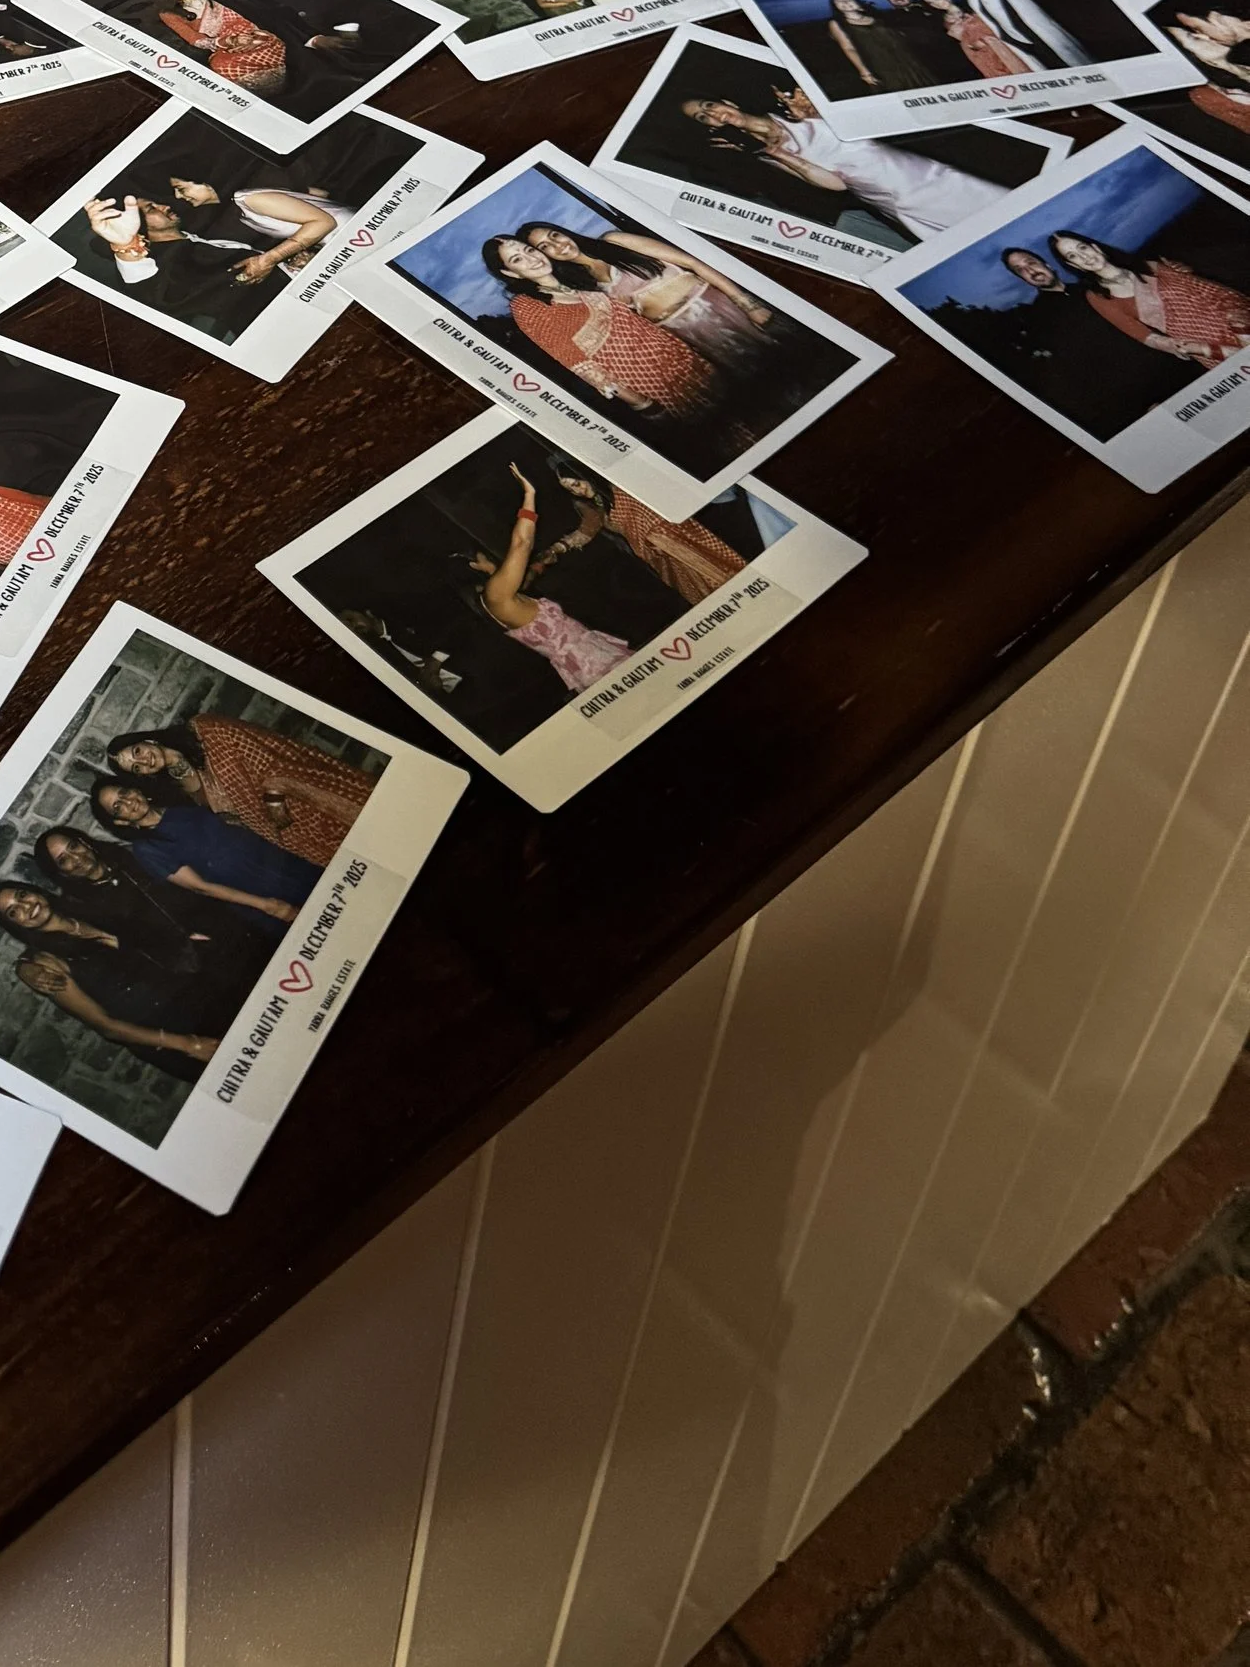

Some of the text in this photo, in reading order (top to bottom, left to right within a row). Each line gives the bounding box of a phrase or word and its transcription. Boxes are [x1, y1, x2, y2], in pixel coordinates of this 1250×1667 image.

[40, 60, 62, 71] 2025
[92, 21, 120, 37] CHITRA
[124, 38, 158, 57] GAUTAM
[177, 66, 219, 91] DECEMBER
[227, 94, 250, 108] 2025
[298, 278, 327, 303] CHITRA
[324, 246, 356, 275] GAUTAM
[364, 199, 400, 231] DECEMBER
[400, 177, 421, 194] 2025
[432, 318, 467, 342] CHITRA
[472, 346, 514, 375] GAUTAM
[538, 390, 591, 428] DECEMBER
[602, 434, 631, 453] 2025
[0, 563, 35, 602] GAUTAM
[43, 495, 83, 538] DECEMBER
[82, 463, 104, 485] 2025
[579, 689, 619, 719] CHITRA
[621, 656, 665, 689] GAUTAM
[684, 604, 737, 642] DECEMBER
[742, 577, 770, 599] 2025
[216, 1058, 253, 1104] CHITRA
[249, 994, 289, 1048] GAUTAM
[298, 902, 344, 962] DECEMBER
[342, 858, 368, 888] 2025
